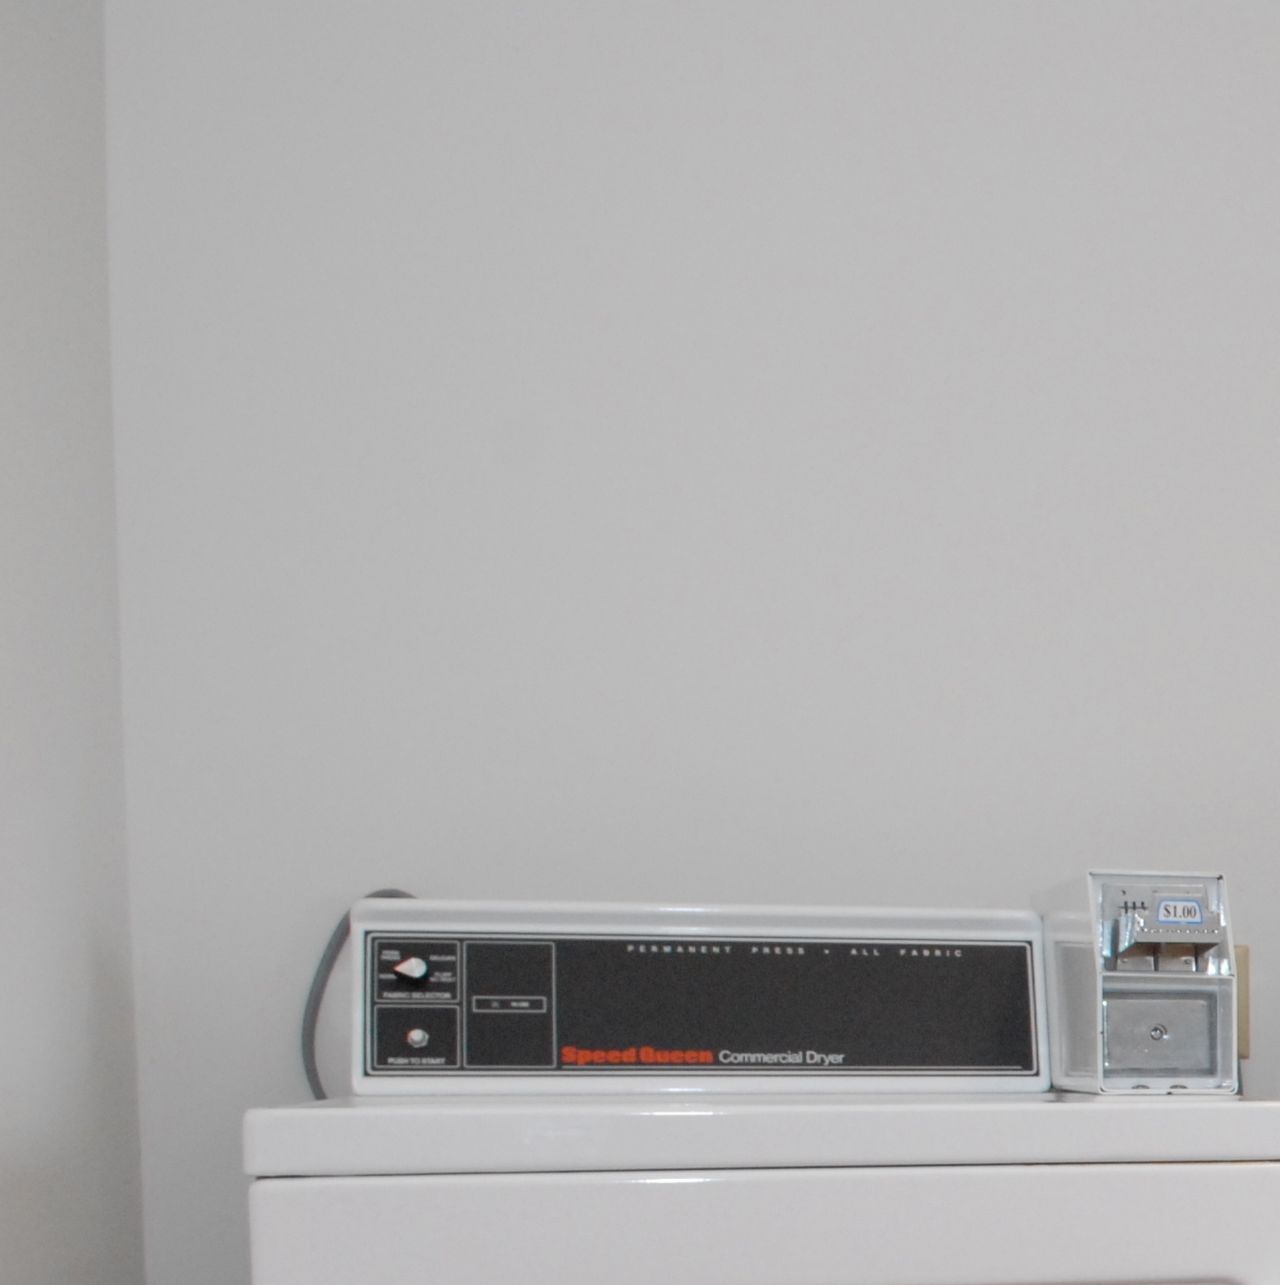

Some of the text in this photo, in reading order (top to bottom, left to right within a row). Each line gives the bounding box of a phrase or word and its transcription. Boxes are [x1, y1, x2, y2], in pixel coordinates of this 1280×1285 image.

[1163, 904, 1197, 918] $1.00
[627, 945, 963, 958] PERMANENT PRESS ALL FABRIC
[387, 1056, 446, 1065] PUSH TO START
[561, 1045, 845, 1066] Speed Queen Commercial Dryer
